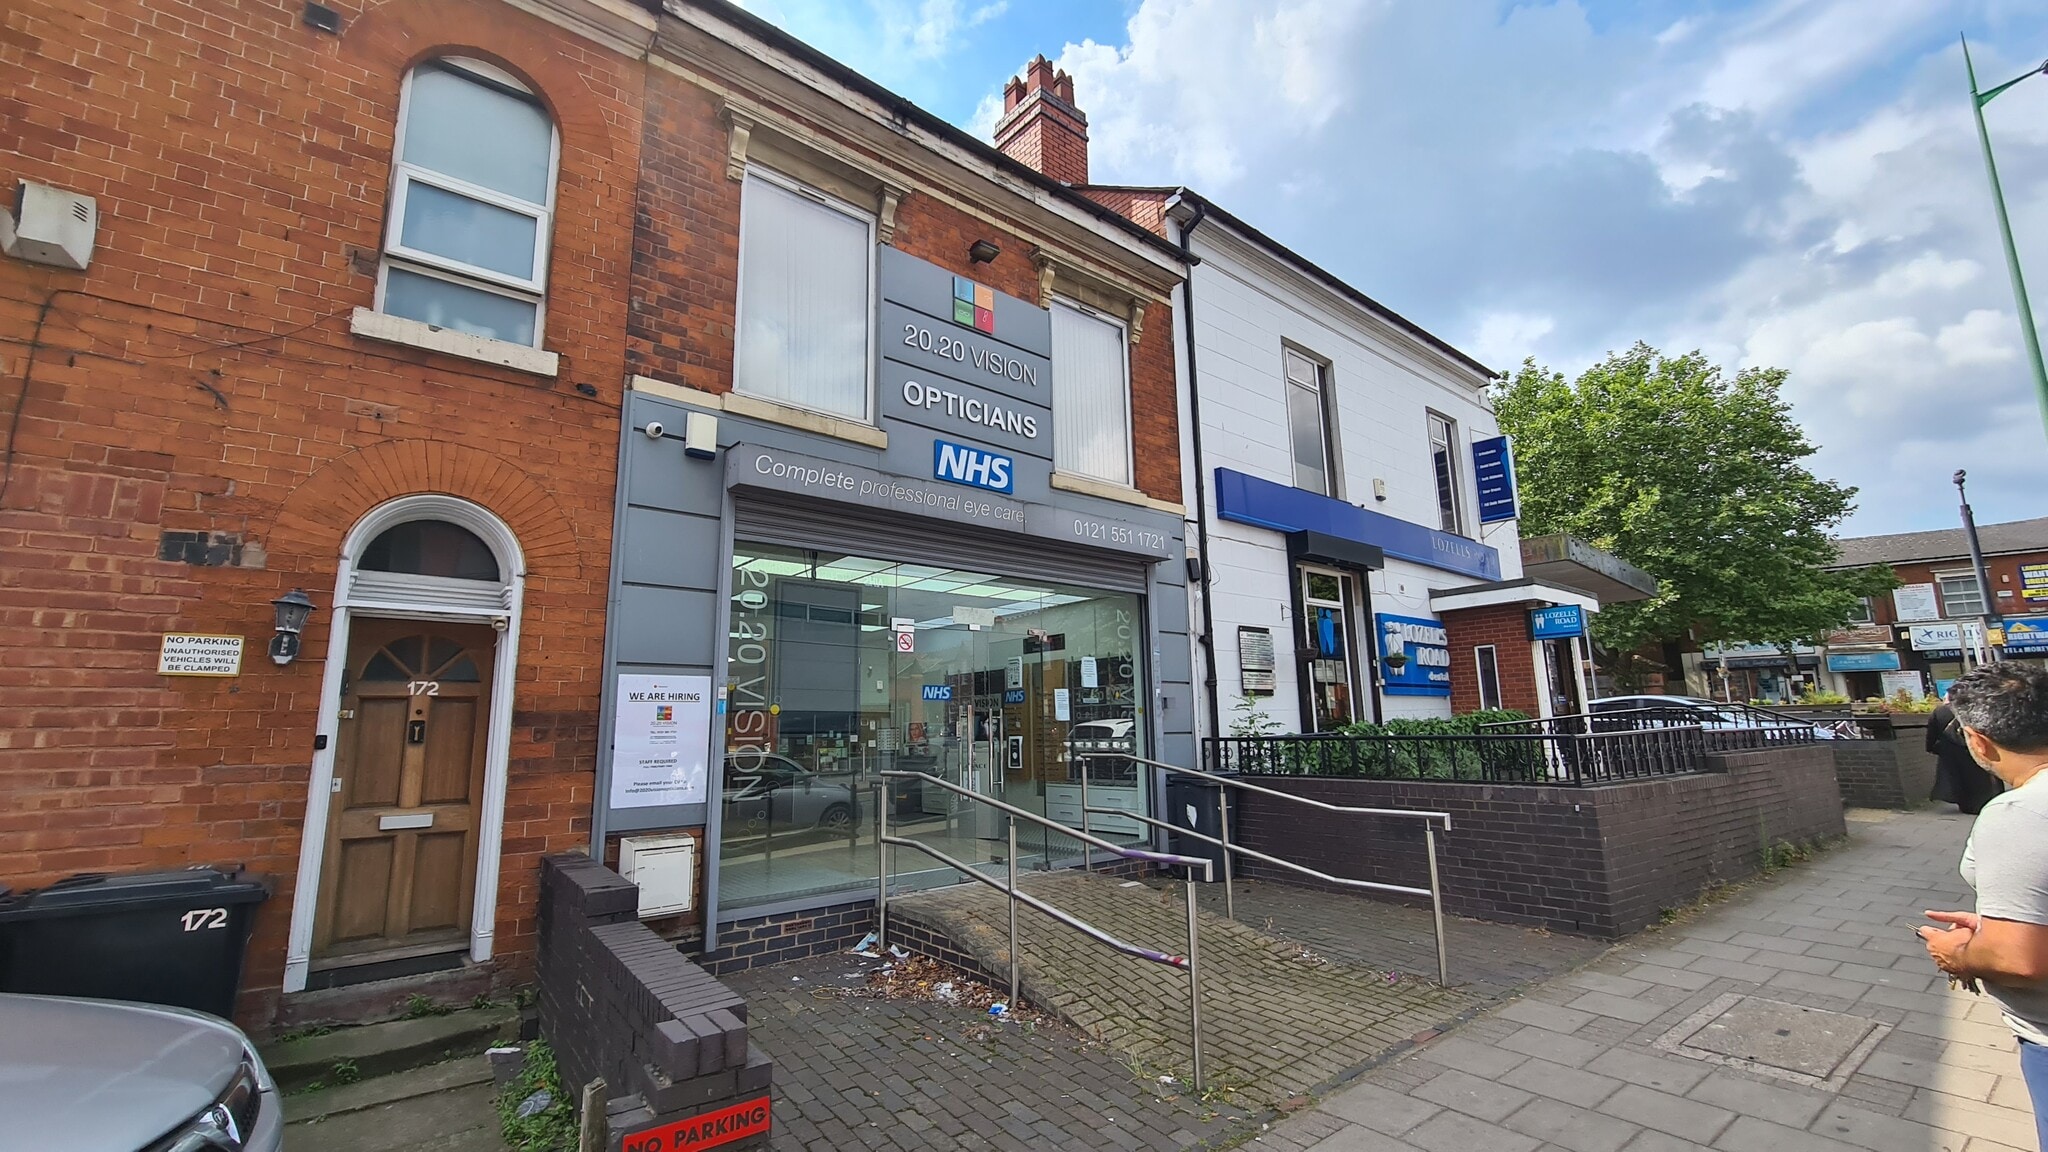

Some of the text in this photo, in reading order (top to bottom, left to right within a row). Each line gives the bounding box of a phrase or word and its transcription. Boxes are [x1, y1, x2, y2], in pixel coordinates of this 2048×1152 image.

[904, 324, 1037, 386] 20.20 VISION
[902, 380, 1037, 438] OPTICIANS
[937, 444, 1010, 489] NHS
[755, 454, 1028, 523] Complete professional eye care.
[1074, 519, 1165, 550] 0121 551 1721
[1431, 536, 1471, 559] LOZELLS
[1545, 610, 1577, 619] LOZELLS
[166, 636, 240, 646] NO PARKING
[1116, 609, 1134, 679] 20.20
[1402, 624, 1448, 646] LOZELLS
[163, 648, 240, 656] UNAUTHORISED
[163, 656, 237, 665] VEHICLES WILL
[1416, 647, 1450, 667] ROAD
[407, 681, 439, 696] 172
[732, 567, 769, 802] 20.20 VISION
[923, 686, 951, 699] NHS
[629, 692, 700, 701] WE ARE HIRING
[1005, 690, 1024, 702] NHS
[181, 907, 228, 931] 172
[674, 1106, 766, 1149] PARKING
